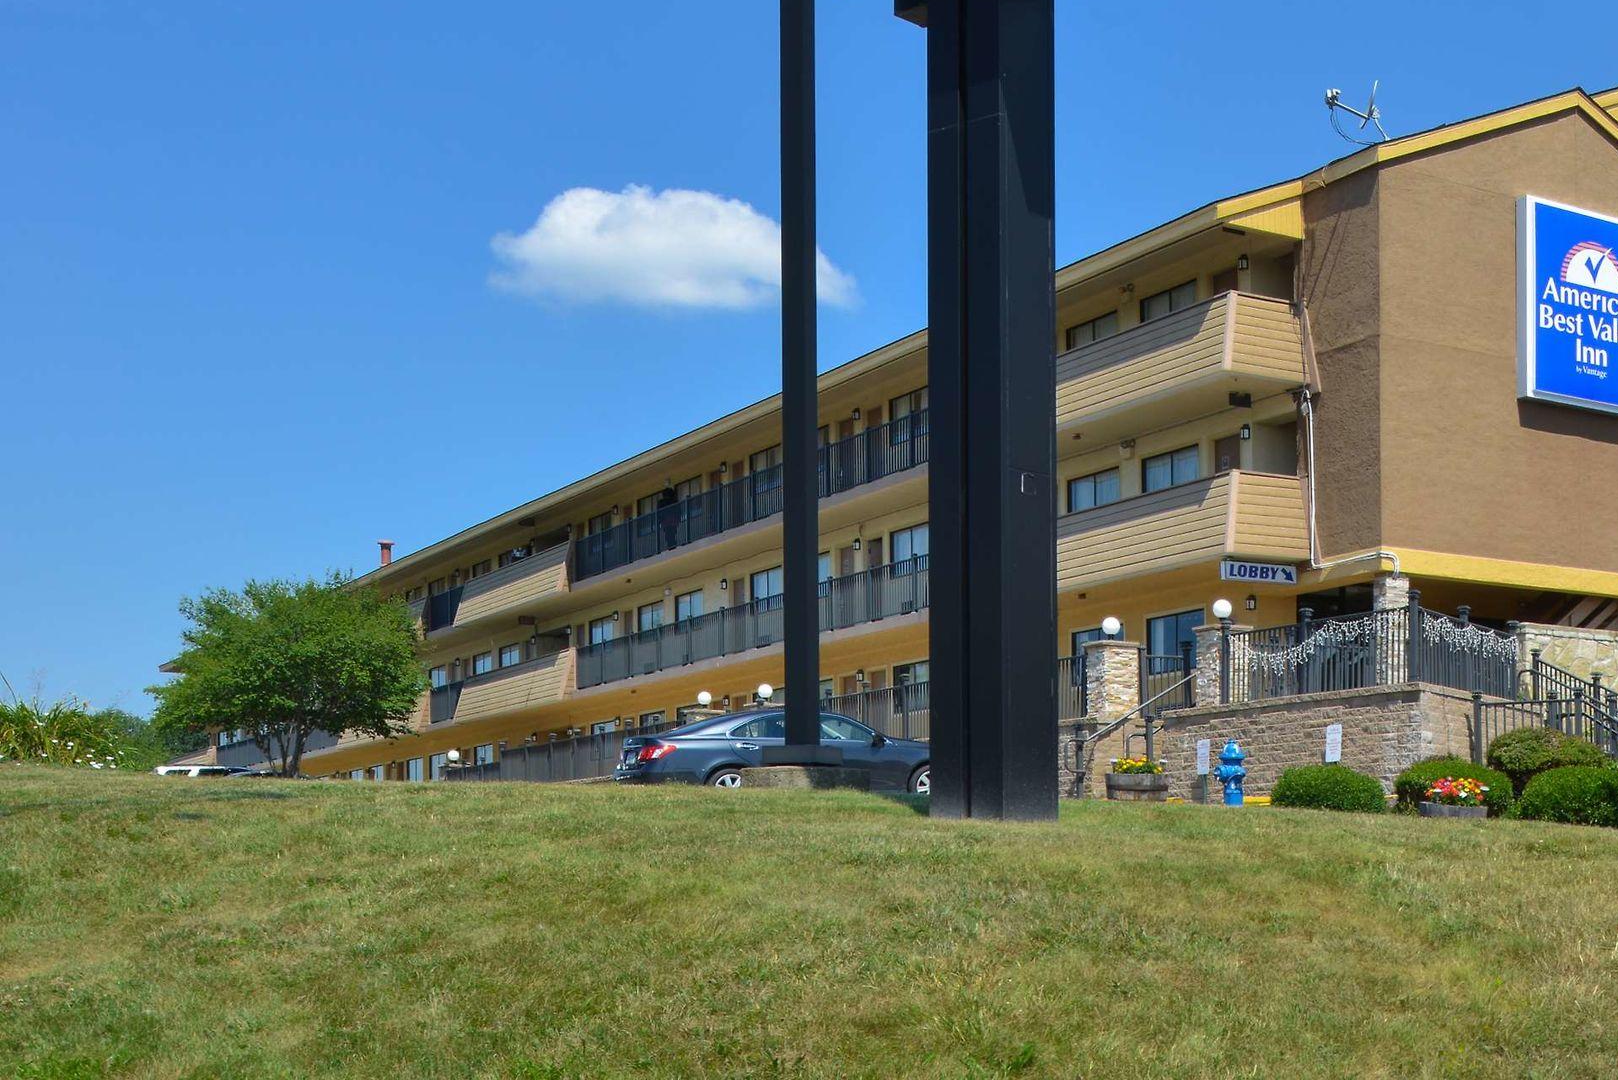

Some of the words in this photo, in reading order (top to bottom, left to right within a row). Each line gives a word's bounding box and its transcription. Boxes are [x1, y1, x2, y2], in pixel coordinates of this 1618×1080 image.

[1539, 303, 1583, 336] Best
[1575, 338, 1608, 367] Inn
[1575, 365, 1583, 375] by
[1582, 365, 1608, 380] Vantage
[1229, 563, 1279, 580] LOBBY
